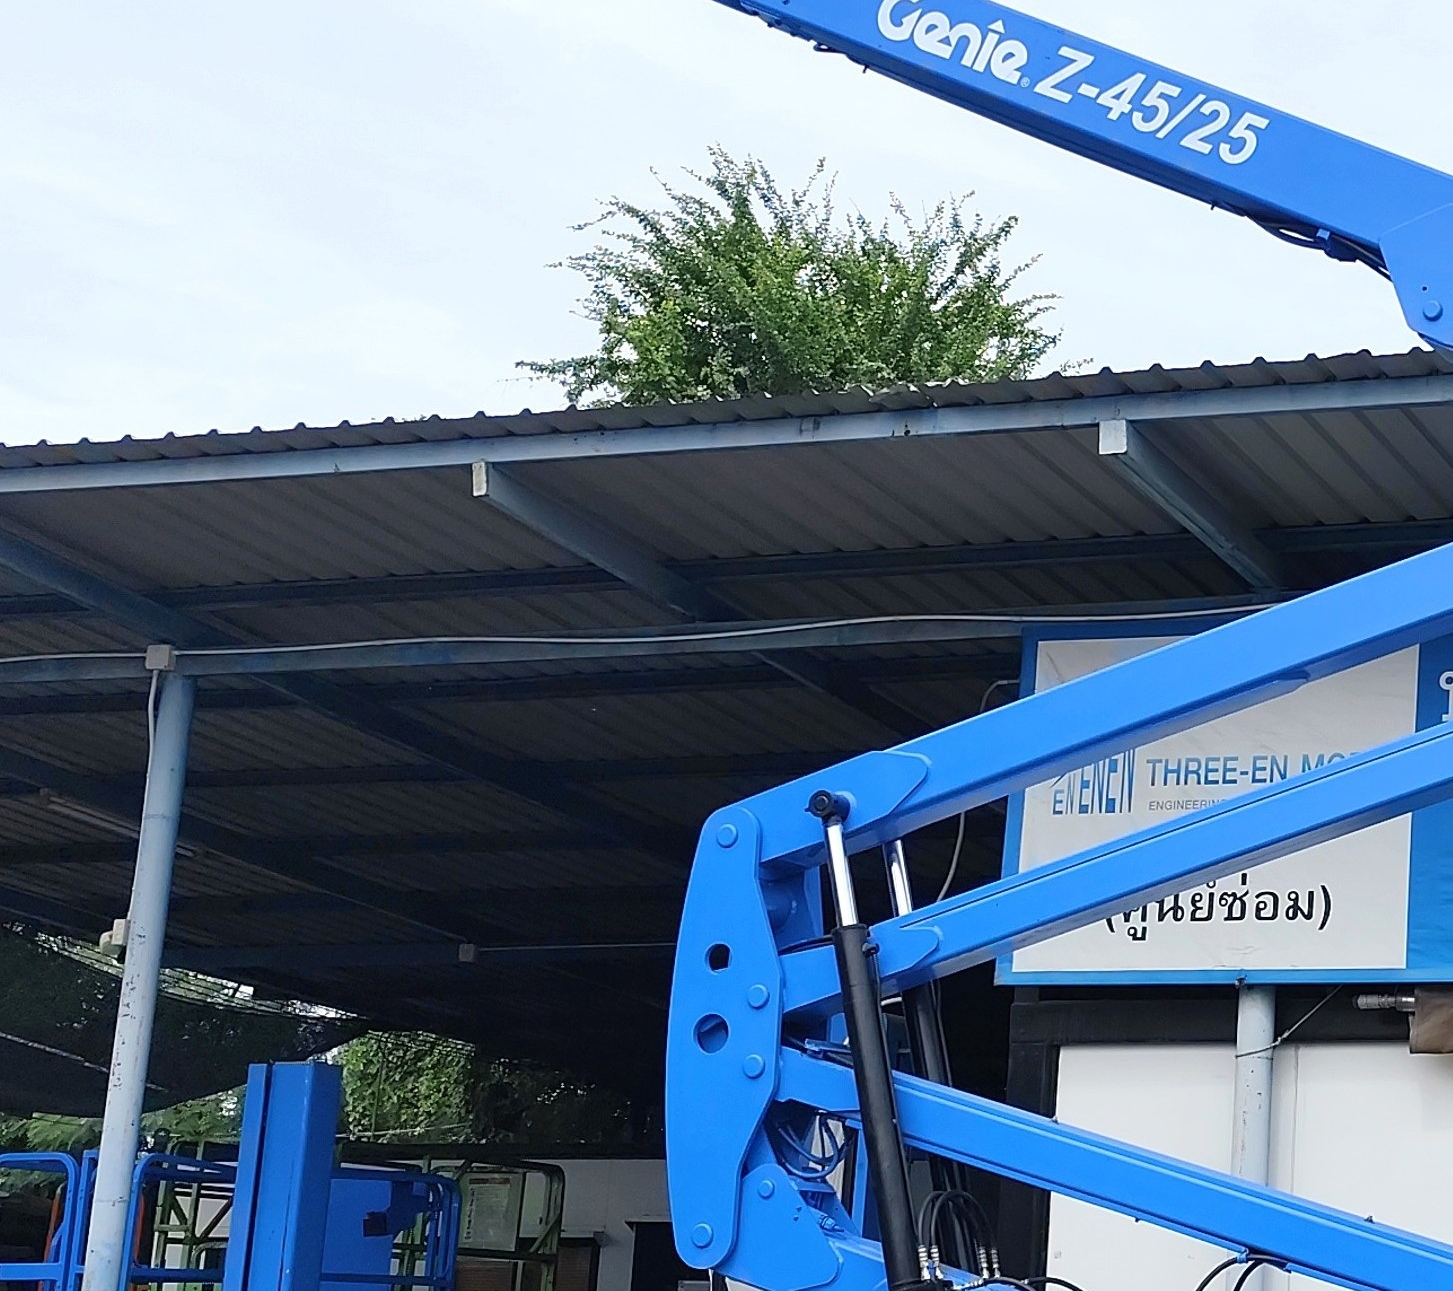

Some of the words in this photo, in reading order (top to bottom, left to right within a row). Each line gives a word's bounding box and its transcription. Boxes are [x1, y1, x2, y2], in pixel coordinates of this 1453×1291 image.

[1034, 46, 1270, 165] Z-45/25
[1146, 754, 1289, 787] THREE-EN
[1149, 799, 1228, 811] ENGINEERI
